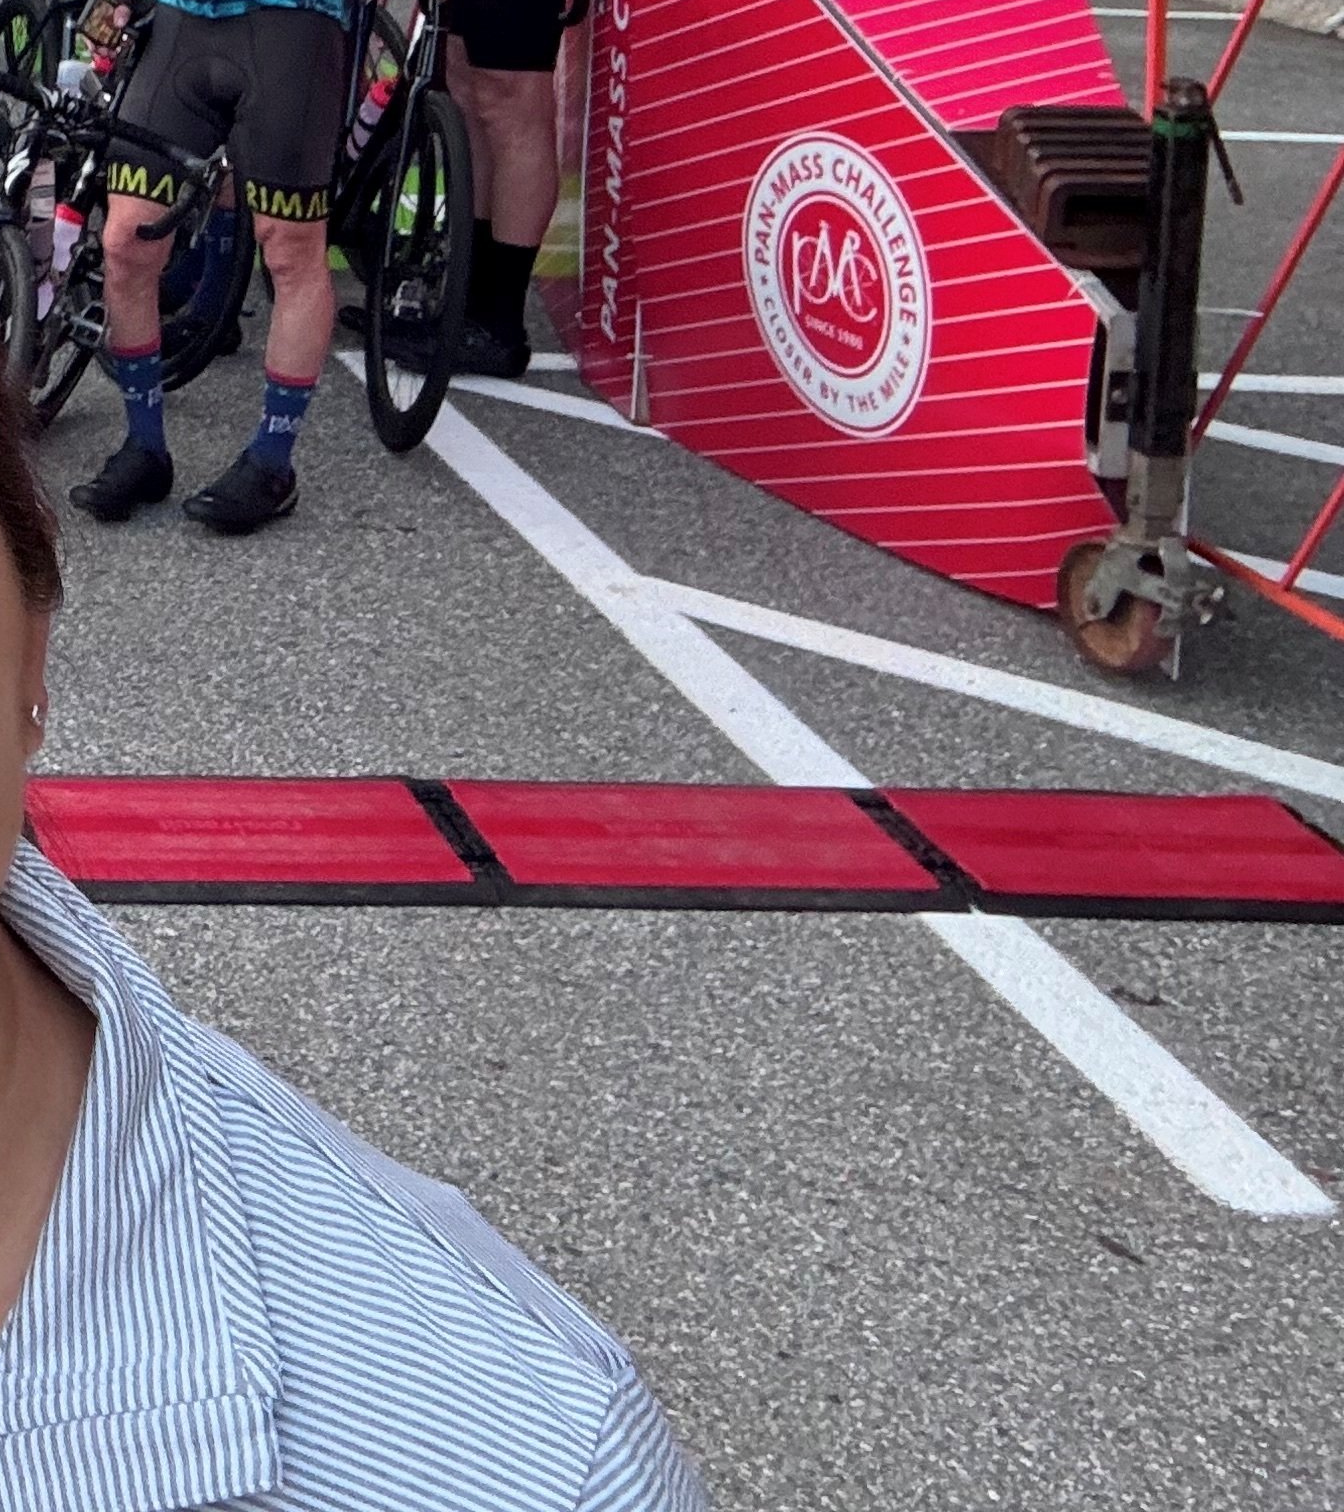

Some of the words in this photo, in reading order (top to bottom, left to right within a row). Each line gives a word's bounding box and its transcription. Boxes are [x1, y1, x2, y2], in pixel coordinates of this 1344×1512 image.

[600, 45, 628, 343] PAN-MASS
[754, 152, 824, 267] PAN-MASS
[832, 157, 918, 328] CHALLENGE
[763, 296, 813, 386] CLOSER
[819, 379, 840, 405] BY
[847, 392, 879, 413] THE
[880, 352, 910, 402] MILE
